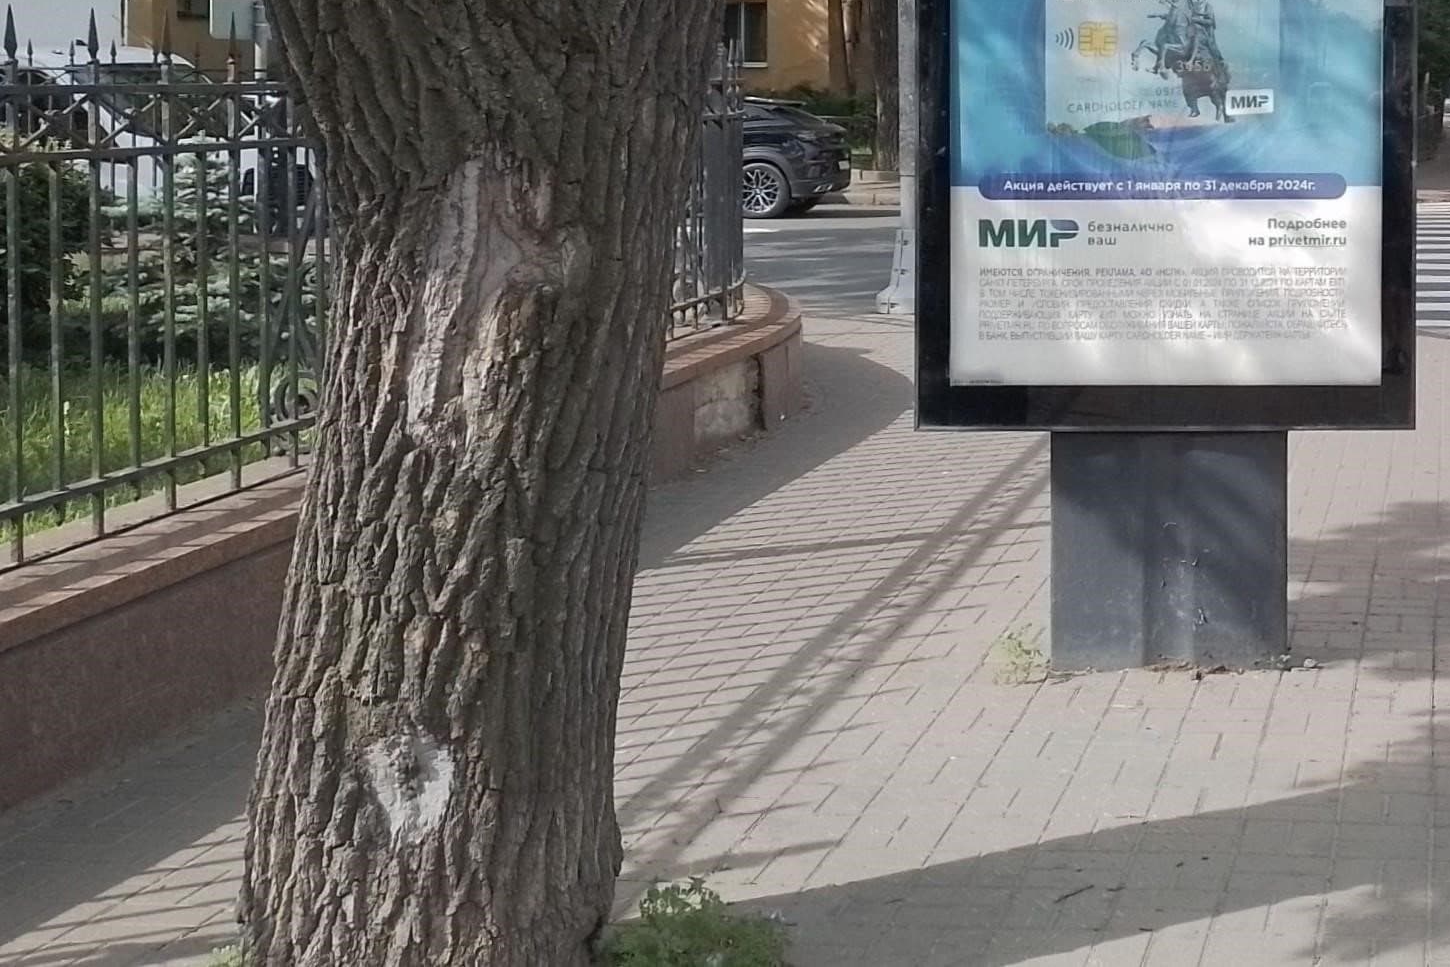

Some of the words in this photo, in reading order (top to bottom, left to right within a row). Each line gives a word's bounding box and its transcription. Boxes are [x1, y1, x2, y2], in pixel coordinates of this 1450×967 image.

[1230, 93, 1270, 109] МИР
[1003, 179, 1044, 193] Акция
[1047, 180, 1113, 193] действует
[1115, 182, 1124, 191] с
[1127, 180, 1132, 191] 1
[1134, 182, 1181, 194] января
[1184, 182, 1200, 191] по
[1204, 180, 1217, 191] 31
[1219, 180, 1273, 193] декабря
[1087, 221, 1174, 233] безналично
[1267, 217, 1347, 232] Подробнее
[978, 219, 1080, 248] МИР
[1087, 236, 1117, 246] ваш
[1248, 237, 1265, 247] на
[1269, 234, 1347, 248] privetmir.ru
